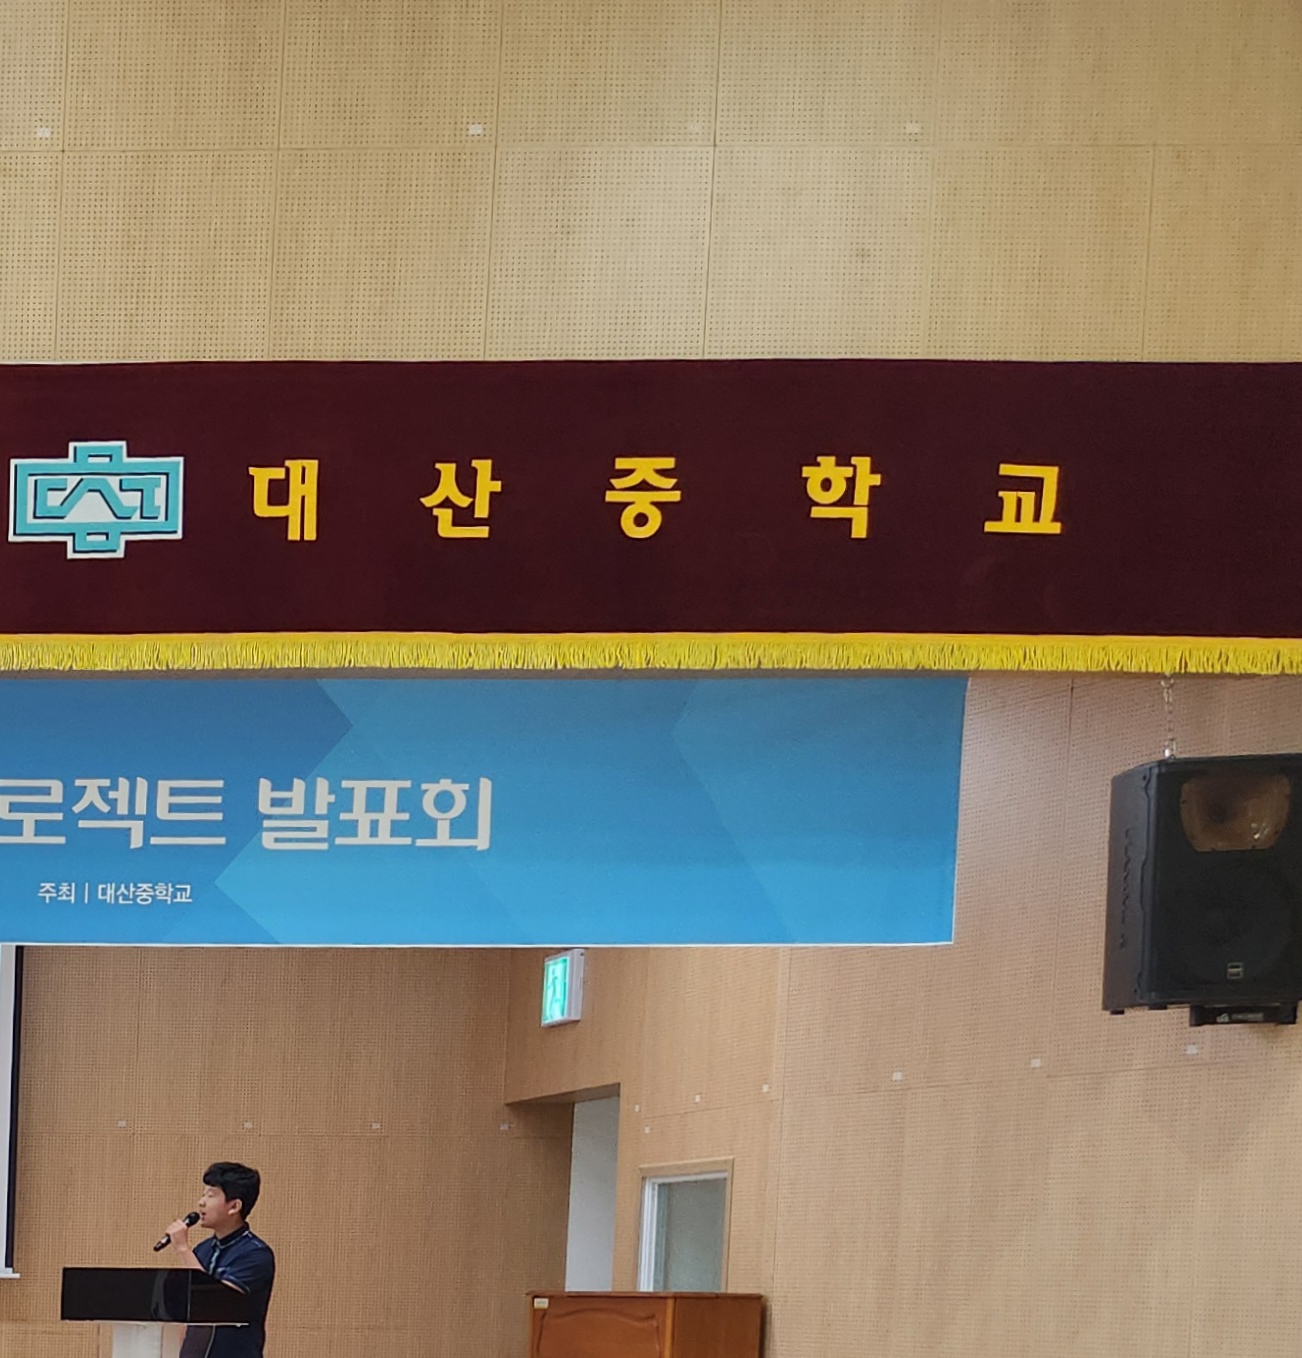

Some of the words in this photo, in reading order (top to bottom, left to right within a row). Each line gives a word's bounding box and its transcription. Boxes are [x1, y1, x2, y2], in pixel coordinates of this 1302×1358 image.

[257, 776, 494, 852] 발표회
[37, 882, 76, 905] 주최
[97, 882, 193, 905] 대산중학교
